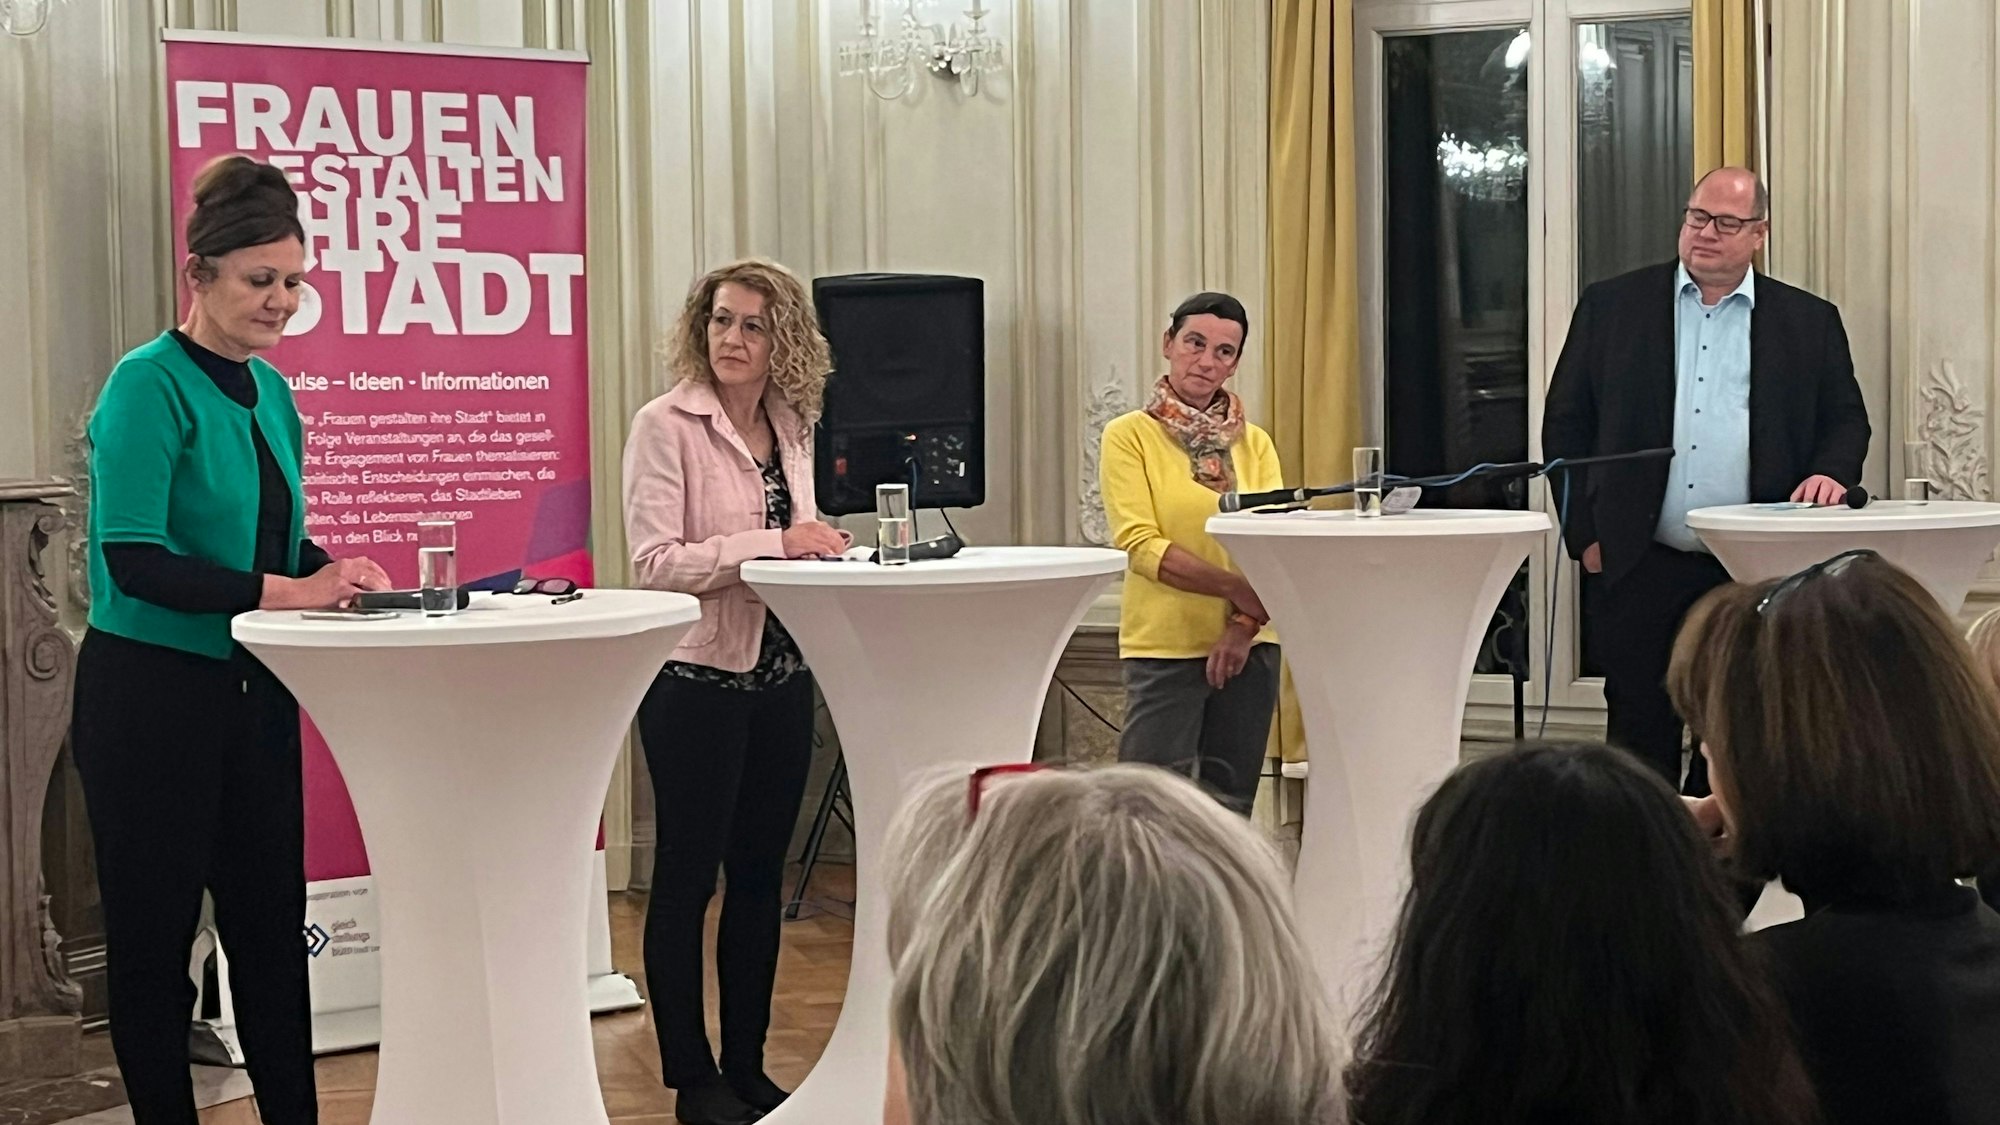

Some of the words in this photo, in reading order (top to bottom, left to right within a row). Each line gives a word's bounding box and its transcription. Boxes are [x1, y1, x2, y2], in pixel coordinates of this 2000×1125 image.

[175, 80, 536, 158] FRAUEN
[269, 154, 564, 203] STALTEN
[297, 191, 465, 262] HRE
[288, 371, 329, 391] ulse
[349, 371, 404, 391] Ideen
[421, 371, 550, 391] Informationen
[369, 411, 428, 429] gestalten
[307, 431, 342, 449] Folge
[344, 431, 444, 448] Veranstaltungen
[468, 429, 487, 443] die
[489, 429, 513, 443] das
[325, 450, 405, 469] Engagement
[406, 453, 429, 464] von
[432, 449, 473, 463] Frauen
[361, 469, 460, 486] Entscheidungen
[536, 466, 556, 480] die
[321, 491, 353, 505] Rolle
[430, 489, 453, 502] das
[331, 532, 342, 544] in
[345, 531, 370, 545] den
[372, 529, 405, 544] Blick
